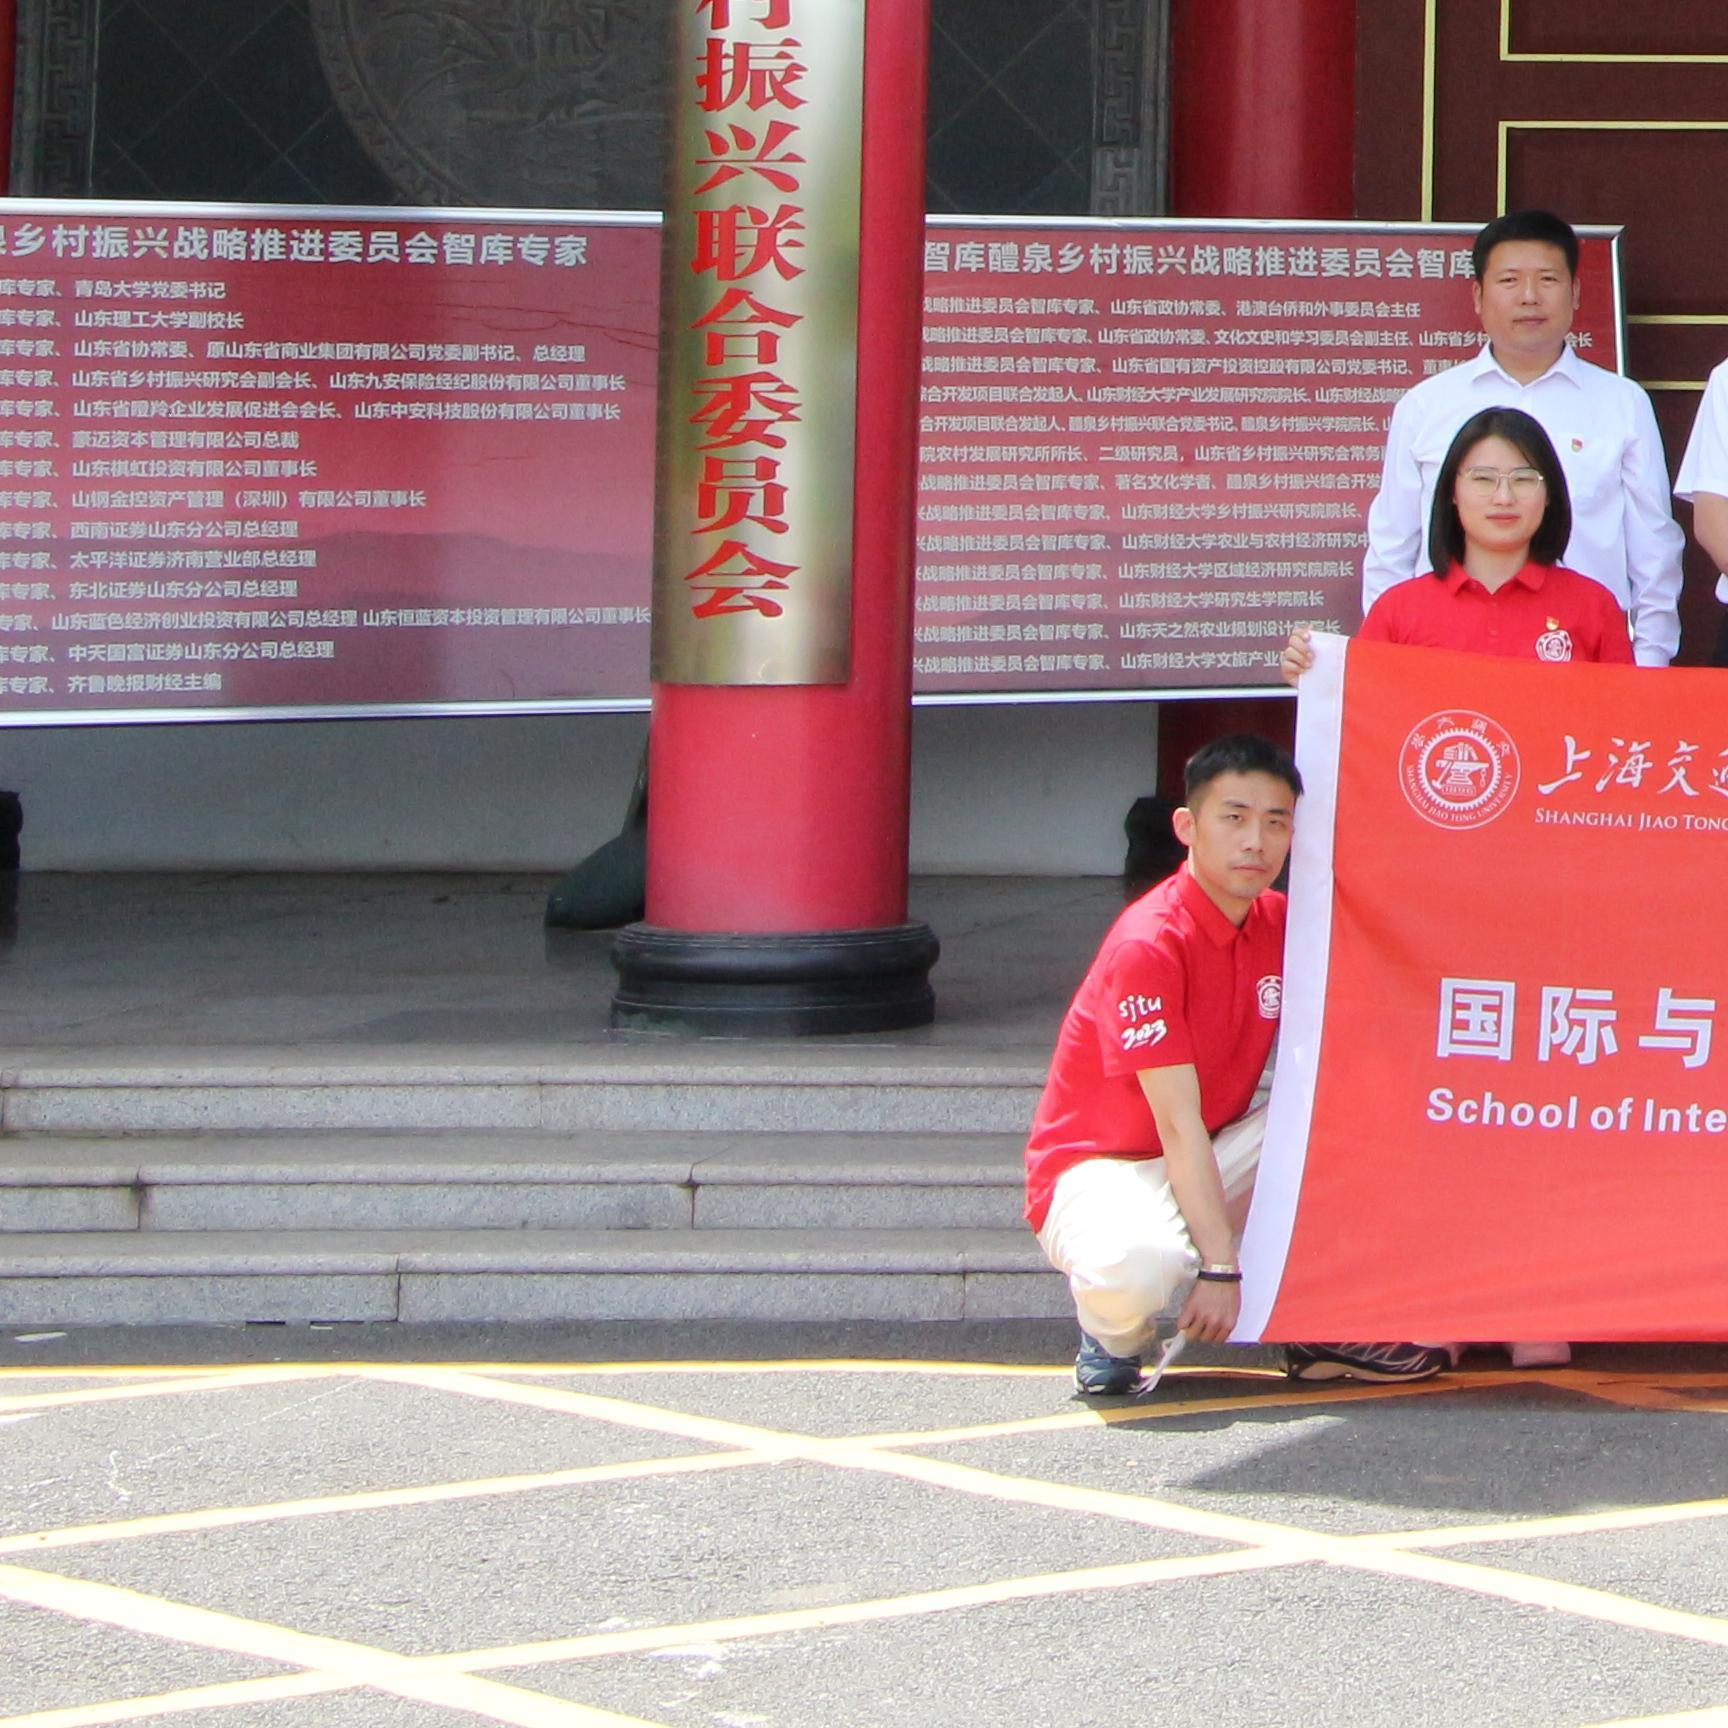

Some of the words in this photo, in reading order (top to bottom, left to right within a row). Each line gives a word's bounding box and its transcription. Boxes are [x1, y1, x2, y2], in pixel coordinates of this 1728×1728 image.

[0, 223, 588, 266] 乡村振兴战略推进委员会智库专家
[1535, 807, 1633, 828] SHANGHAI
[1639, 812, 1678, 832] JIAO
[1118, 994, 1163, 1022] sjtu
[1121, 1019, 1168, 1051] 2023
[1426, 1087, 1578, 1130] School
[1590, 1097, 1634, 1131] of
